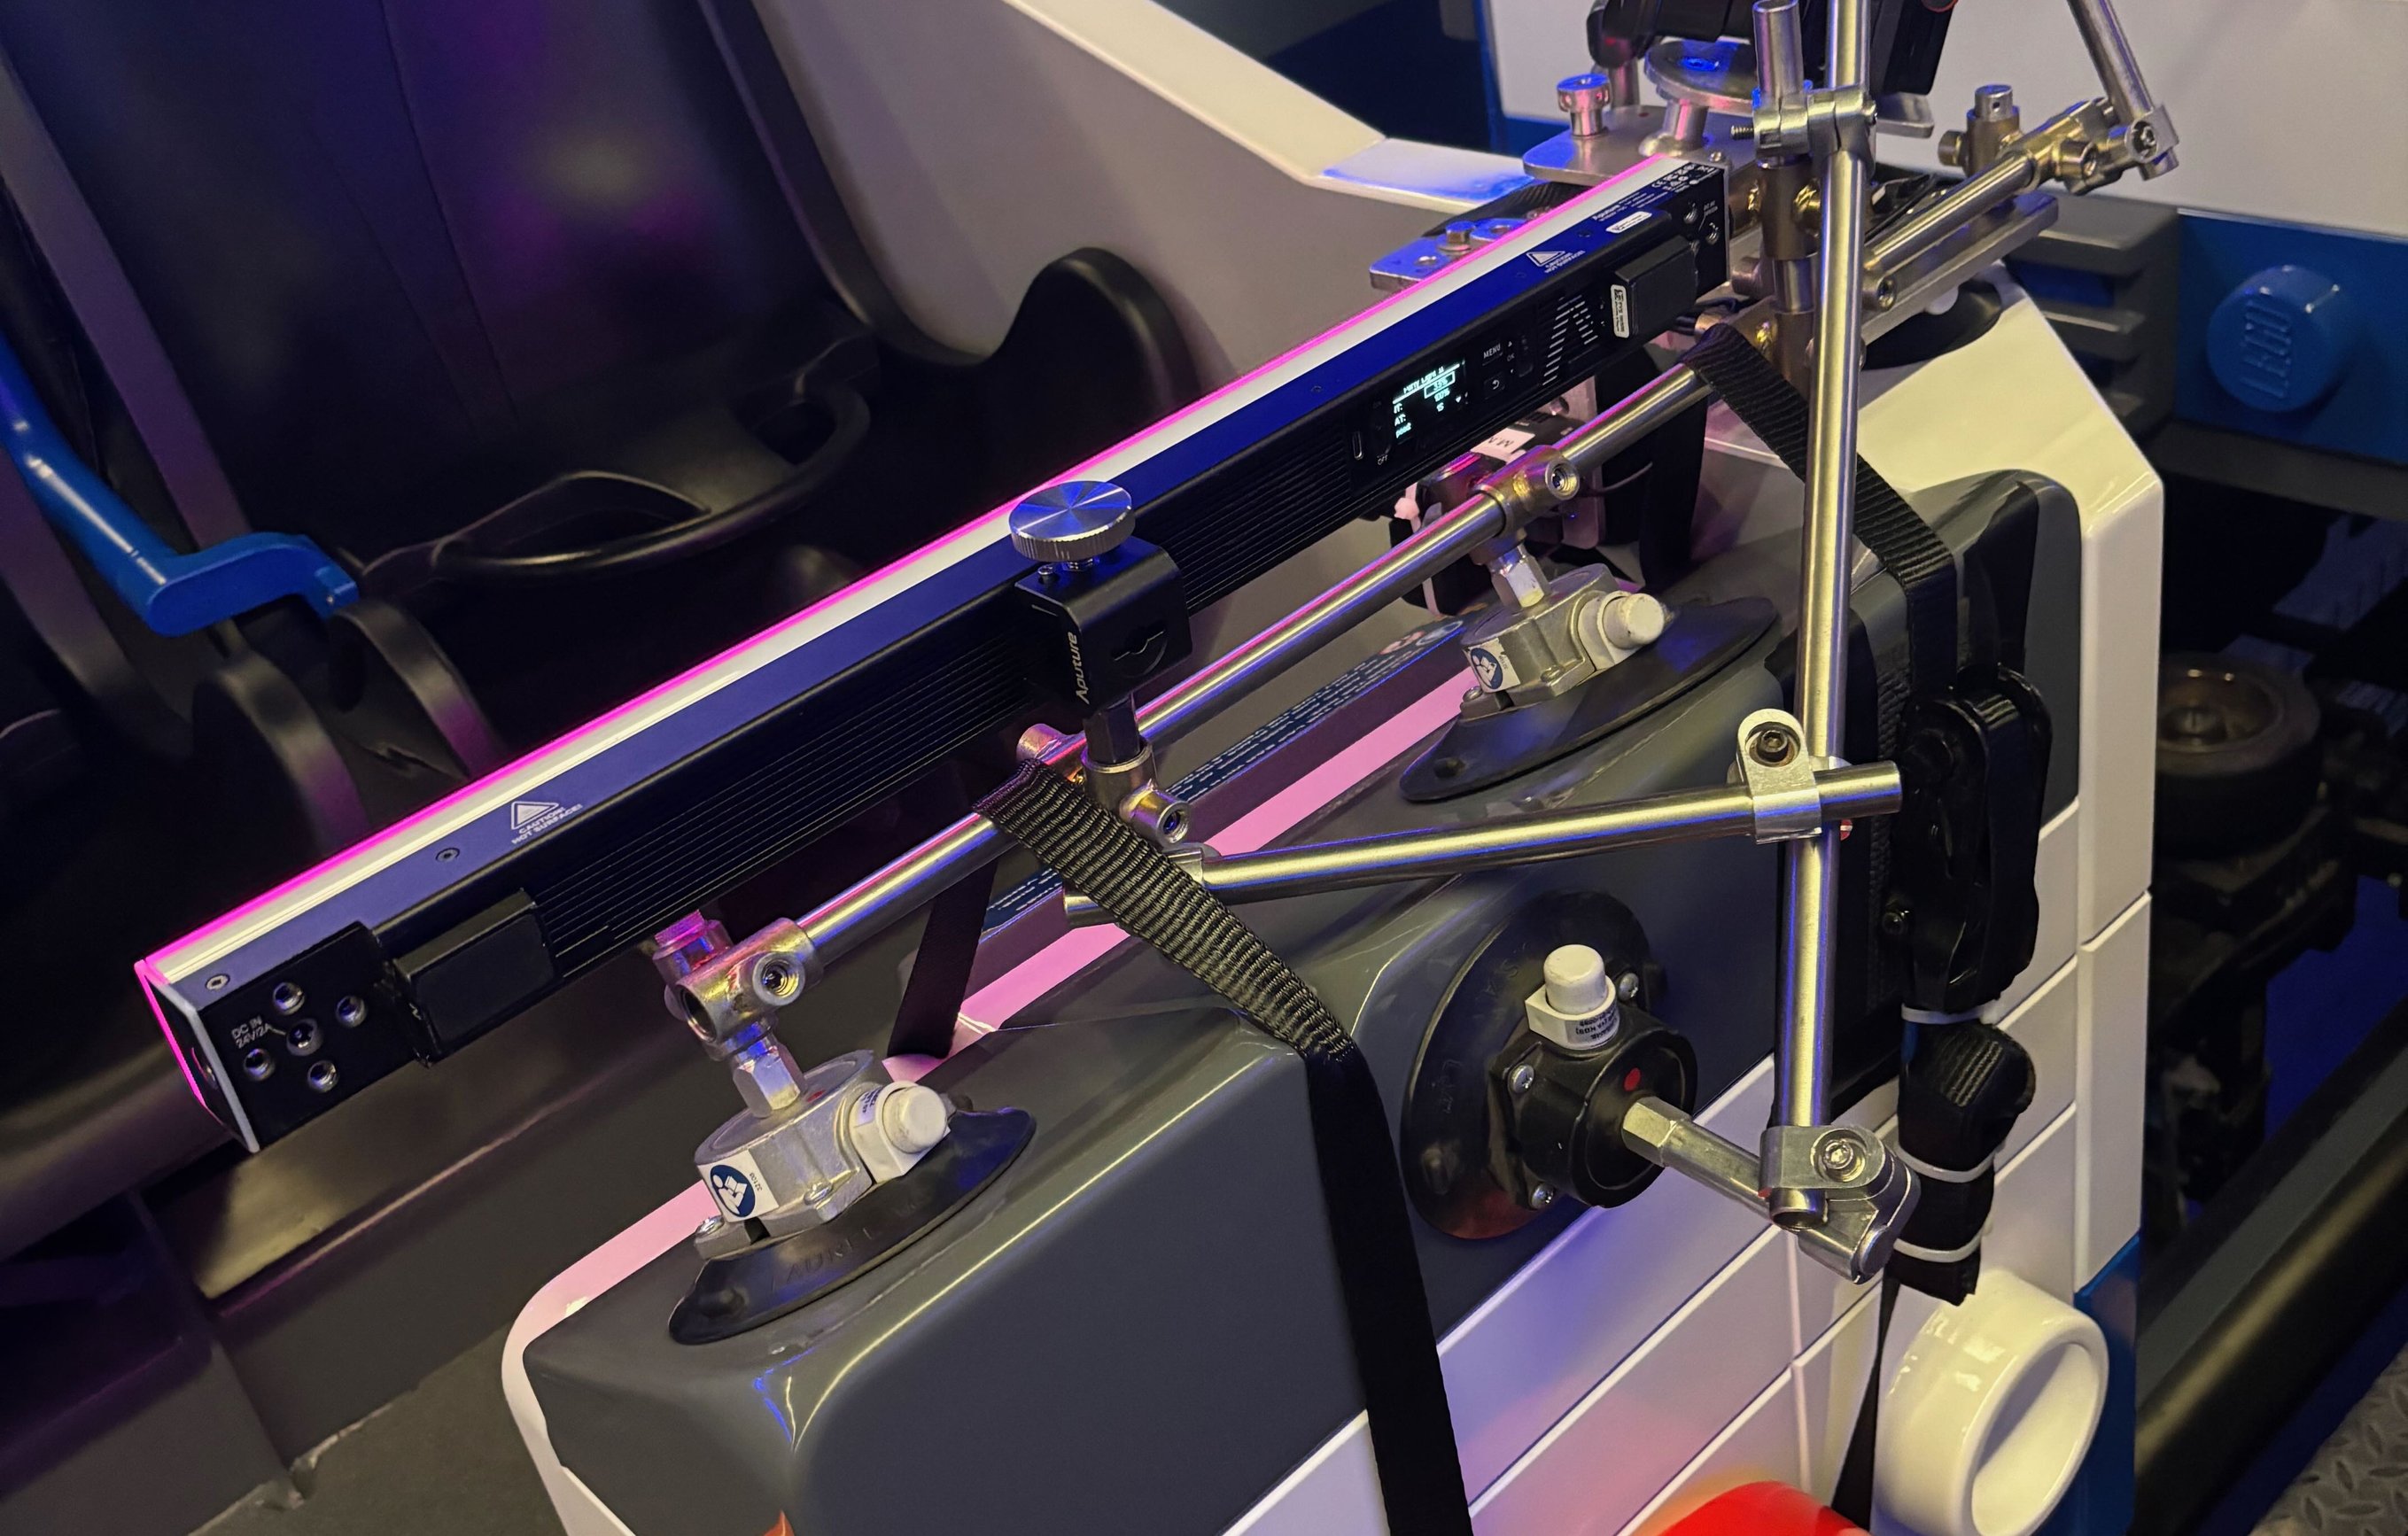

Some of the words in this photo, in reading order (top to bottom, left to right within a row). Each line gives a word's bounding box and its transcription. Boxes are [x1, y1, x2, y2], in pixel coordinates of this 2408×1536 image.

[1483, 343, 1501, 359] MENU
[1068, 632, 1090, 704] Aputure
[511, 831, 532, 844] HOT
[231, 1023, 249, 1040] DC
